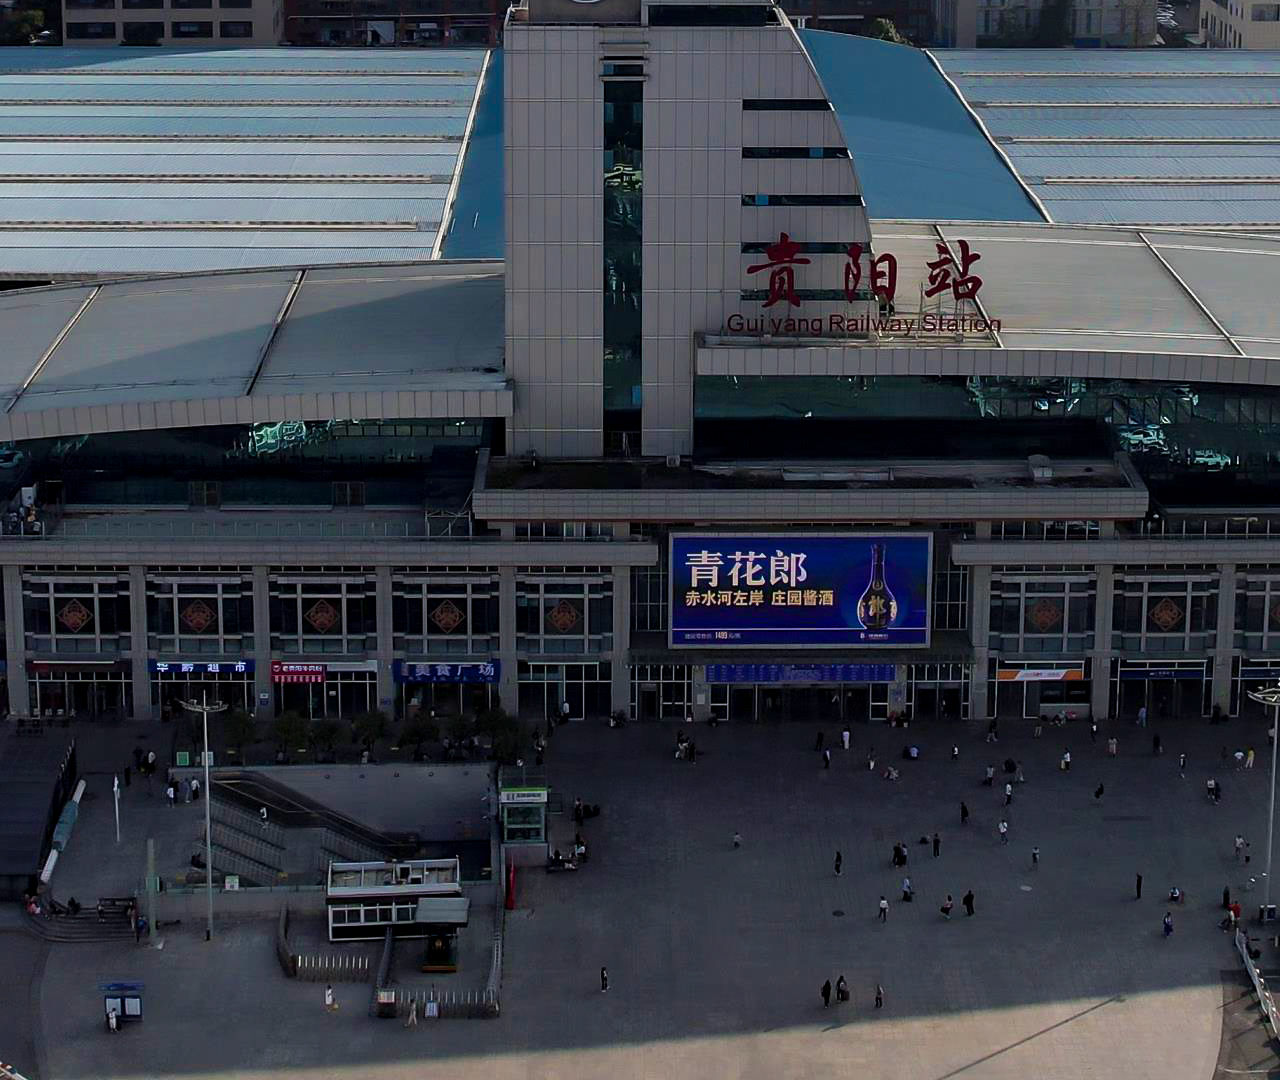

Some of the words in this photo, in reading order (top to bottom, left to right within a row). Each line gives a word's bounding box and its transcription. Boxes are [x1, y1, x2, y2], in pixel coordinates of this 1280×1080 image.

[747, 232, 982, 307] 贵阳站
[830, 314, 913, 336] Railway
[922, 314, 1001, 332] Station
[685, 550, 807, 587] 青花郎
[685, 590, 764, 606] 赤水河左岸
[771, 590, 834, 606] 庄园酱酒
[415, 663, 494, 676] 美食广场
